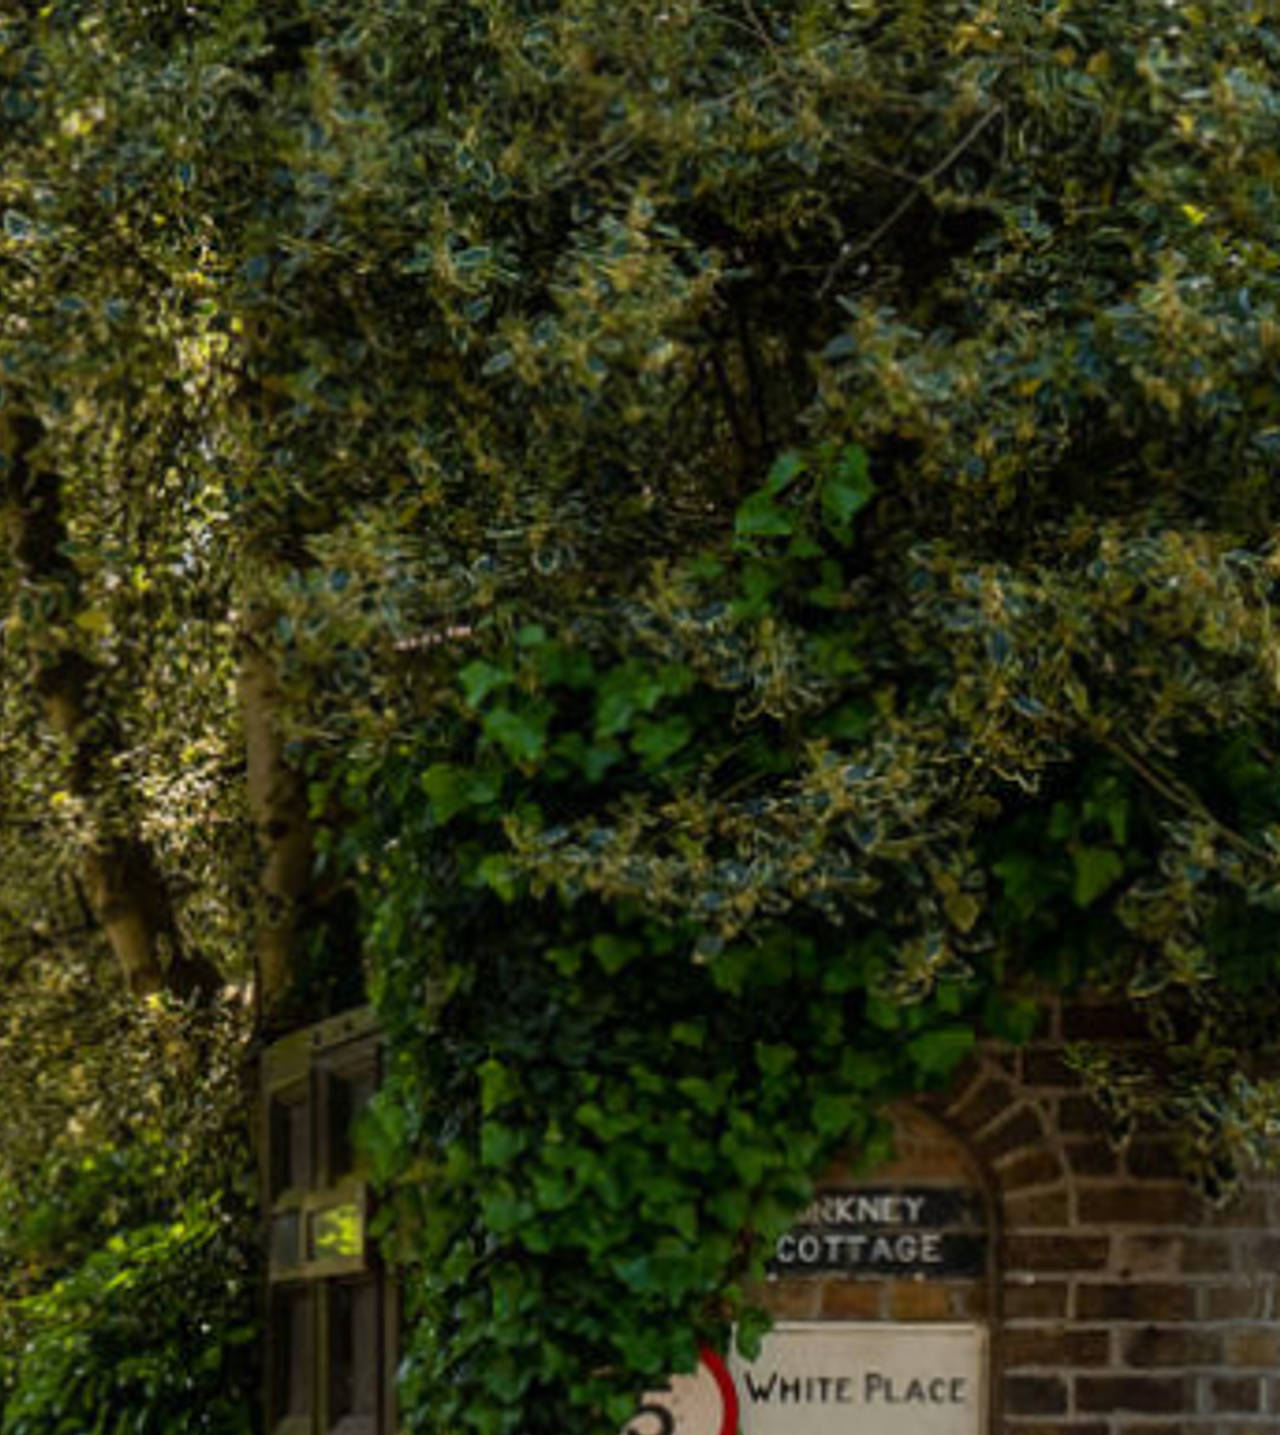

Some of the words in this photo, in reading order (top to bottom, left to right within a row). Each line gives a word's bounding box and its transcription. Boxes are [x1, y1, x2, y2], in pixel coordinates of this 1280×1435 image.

[776, 1233, 943, 1263] COTTAGE
[744, 1372, 852, 1403] WHITE
[864, 1373, 968, 1404] PLACE
